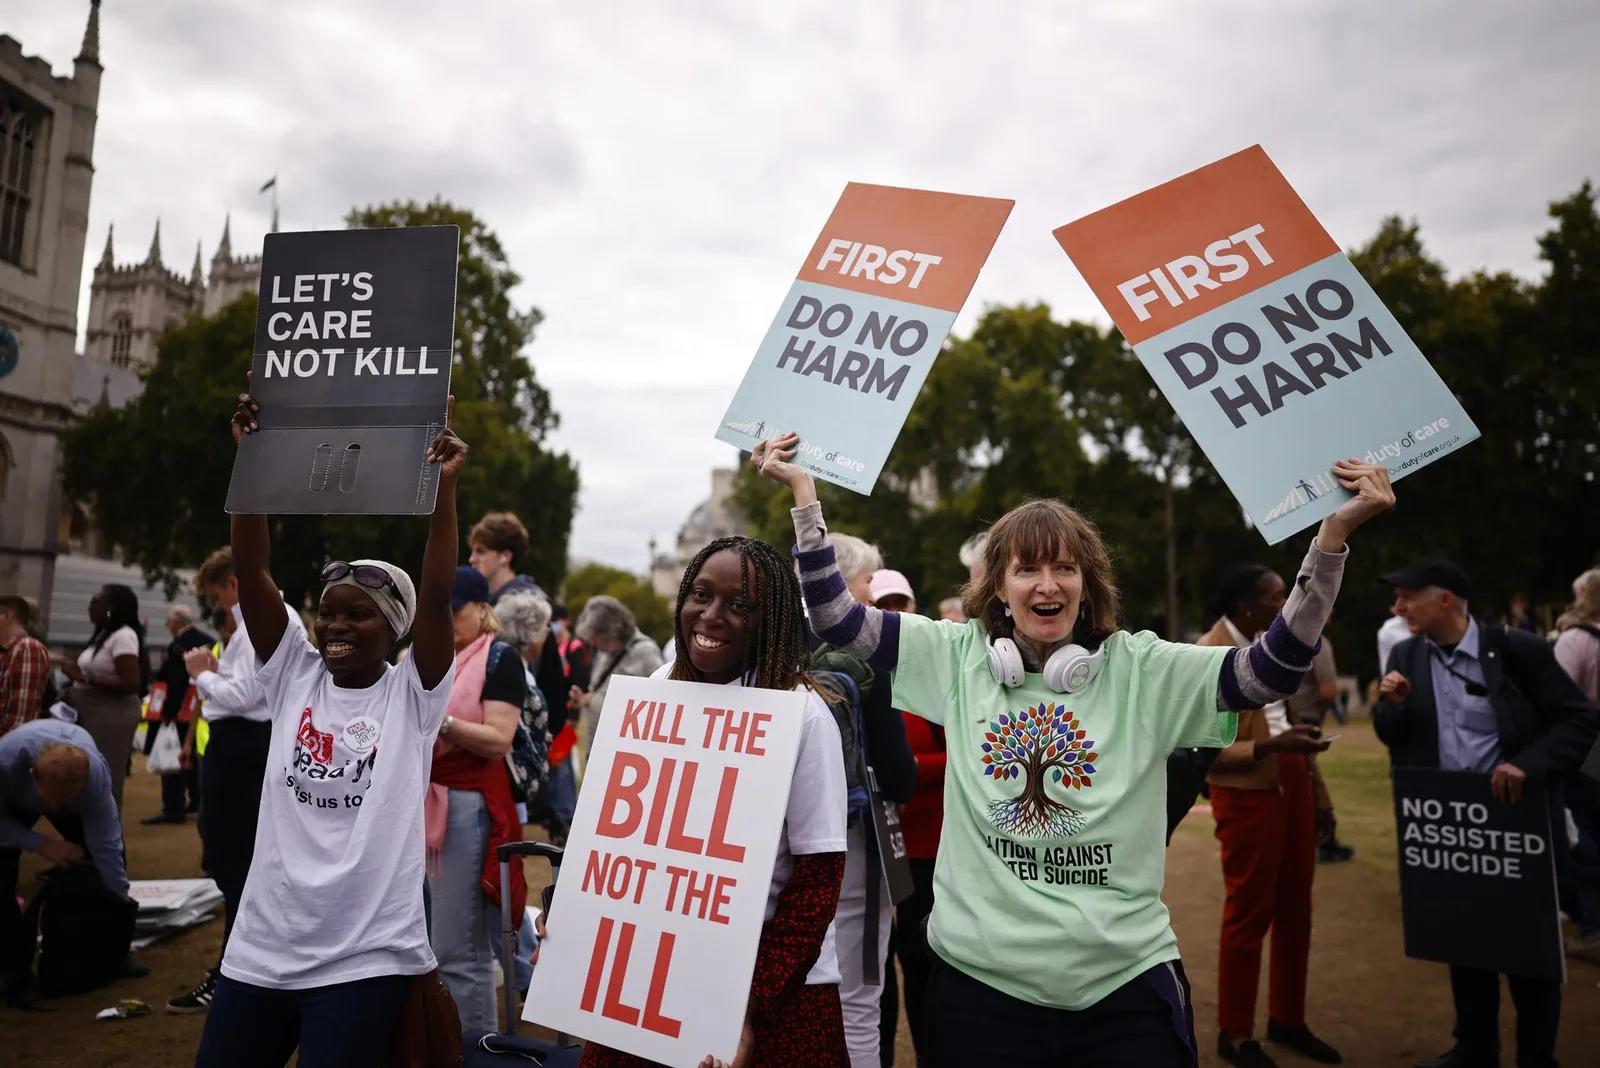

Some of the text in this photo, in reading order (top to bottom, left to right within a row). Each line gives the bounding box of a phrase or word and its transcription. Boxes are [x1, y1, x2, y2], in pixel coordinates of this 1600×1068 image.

[816, 238, 943, 289] FIRST
[1116, 223, 1275, 322] FIRST
[271, 272, 374, 304] LET'S
[267, 309, 373, 341] CARE
[786, 295, 929, 357] DO NO
[1163, 278, 1355, 391] DO NO
[264, 346, 439, 378] NOT KILL
[775, 335, 912, 402] HARM
[1209, 316, 1394, 429] HARM
[798, 440, 865, 472] duty of care
[1364, 417, 1450, 465] duty of care
[619, 698, 773, 757] KILL THE
[316, 797, 338, 809] us
[344, 794, 363, 809] to
[595, 750, 747, 864] BILL
[1402, 797, 1488, 824] NO TO
[1043, 843, 1113, 867] AGAINST
[1404, 822, 1546, 855] ASSISTED
[1405, 846, 1522, 879] SUICIDE
[581, 849, 738, 925] NOT THE
[1044, 865, 1109, 886] SUICIDE
[579, 916, 682, 1040] ILL
